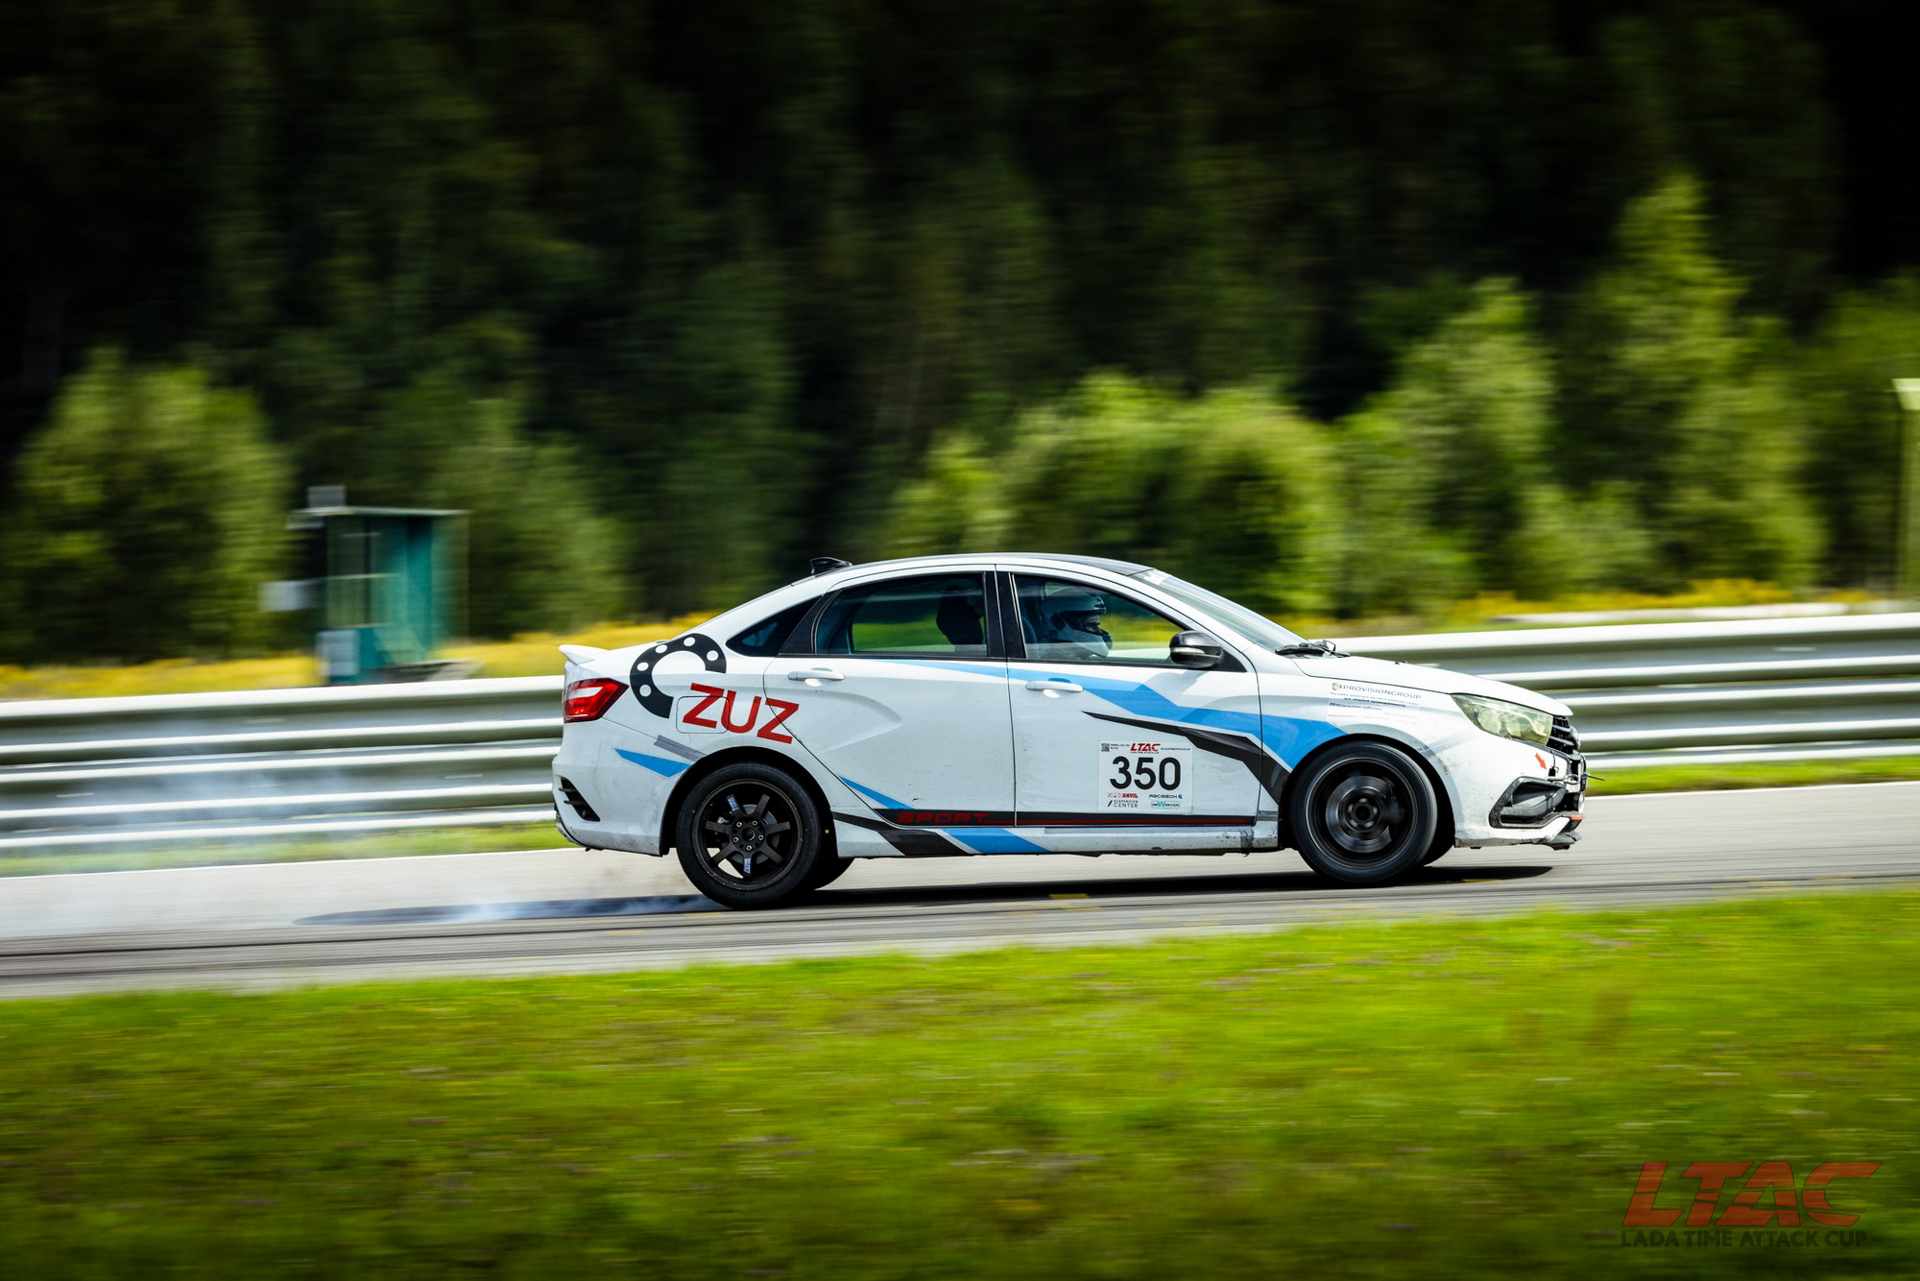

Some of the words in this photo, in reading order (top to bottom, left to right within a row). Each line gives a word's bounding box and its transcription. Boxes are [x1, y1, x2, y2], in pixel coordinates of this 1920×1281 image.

[1343, 685, 1422, 699] PROVISIONGROUP
[682, 682, 799, 744] ZUZ
[1130, 743, 1161, 752] LTAC
[1110, 756, 1181, 791] 350
[898, 811, 989, 823] SPORT
